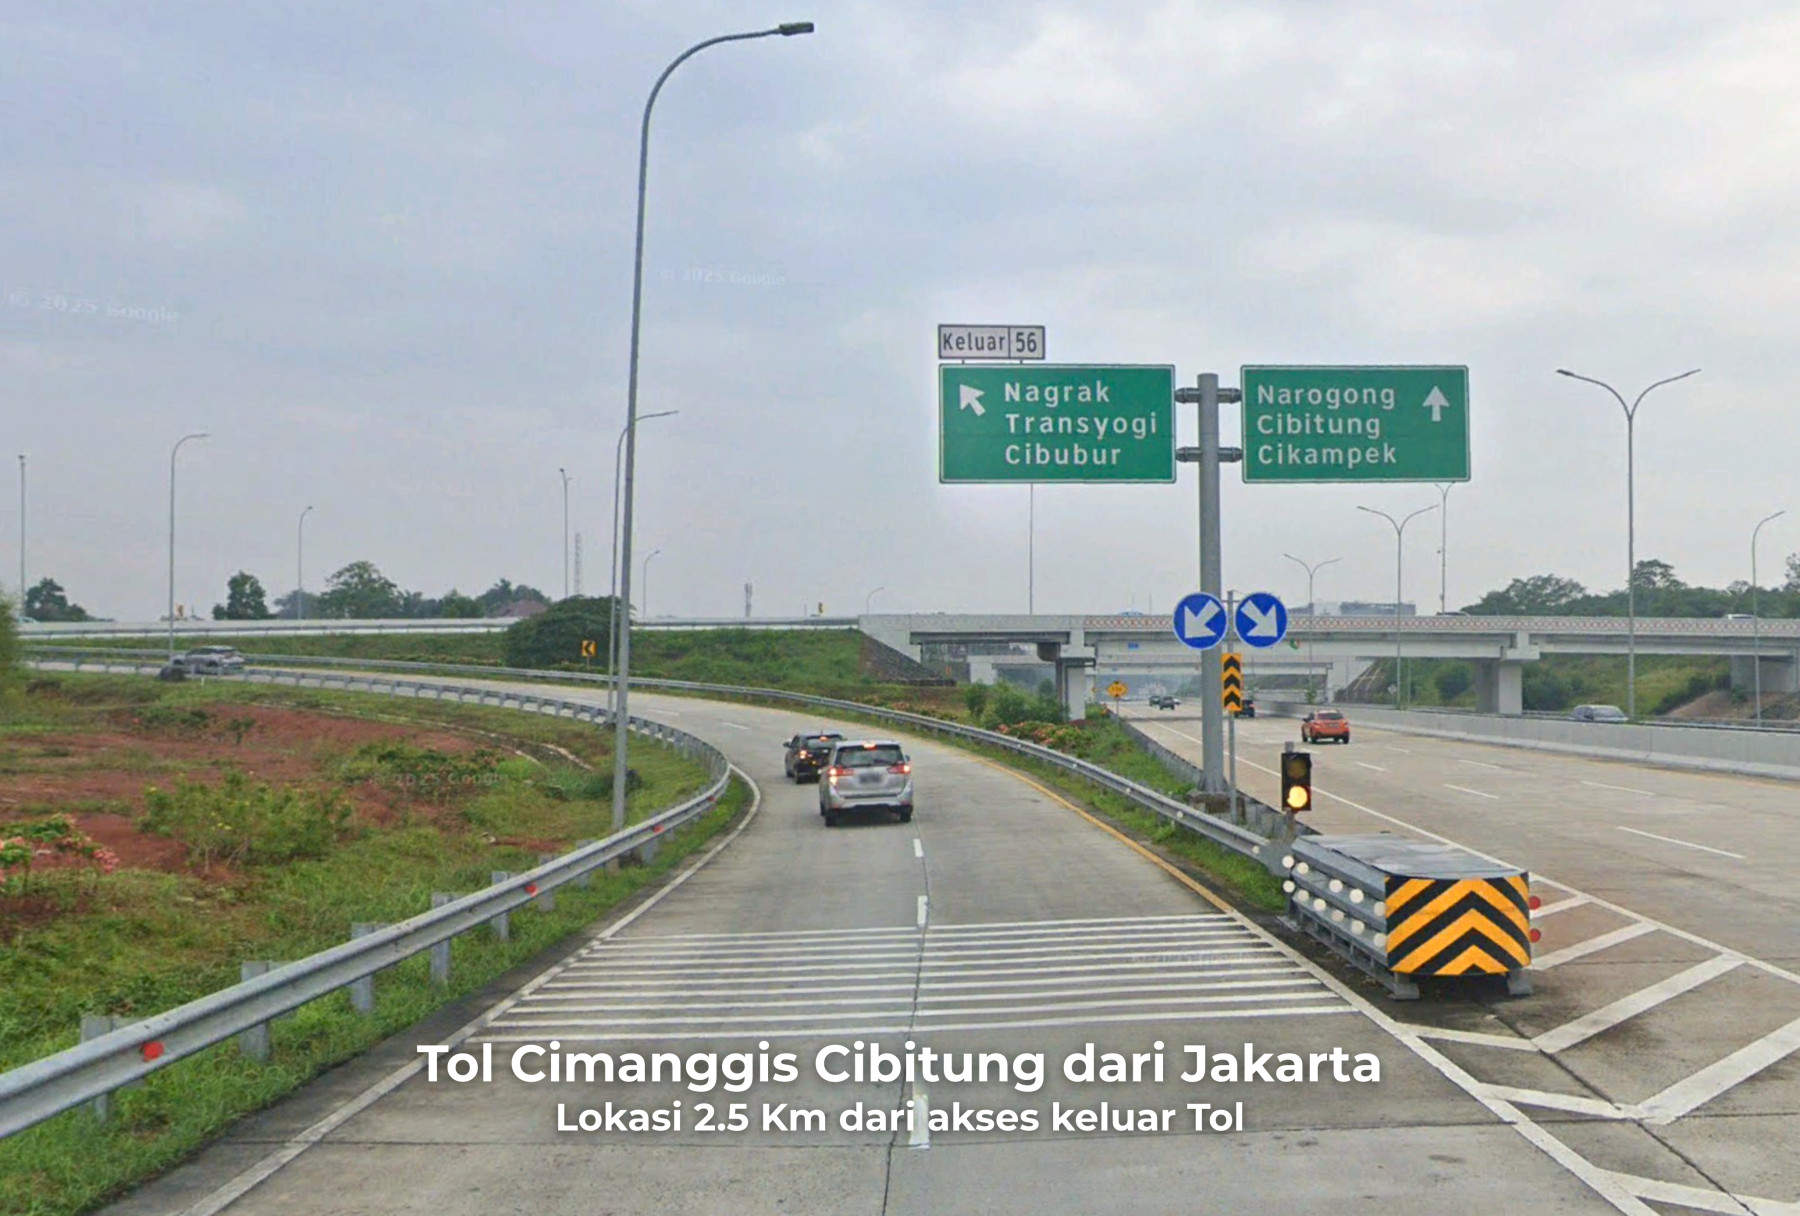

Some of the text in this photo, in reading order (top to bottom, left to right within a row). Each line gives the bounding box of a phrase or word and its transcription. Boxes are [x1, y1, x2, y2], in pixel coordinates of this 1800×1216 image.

[942, 331, 1038, 353] Keluar 56
[1004, 380, 1110, 408] Nagrak
[1258, 385, 1395, 410] Narogong
[1005, 413, 1157, 440] Transyogi
[1257, 413, 1380, 439] Cibitung
[1005, 443, 1121, 466] Cibubur
[1258, 443, 1396, 469] Cikampek
